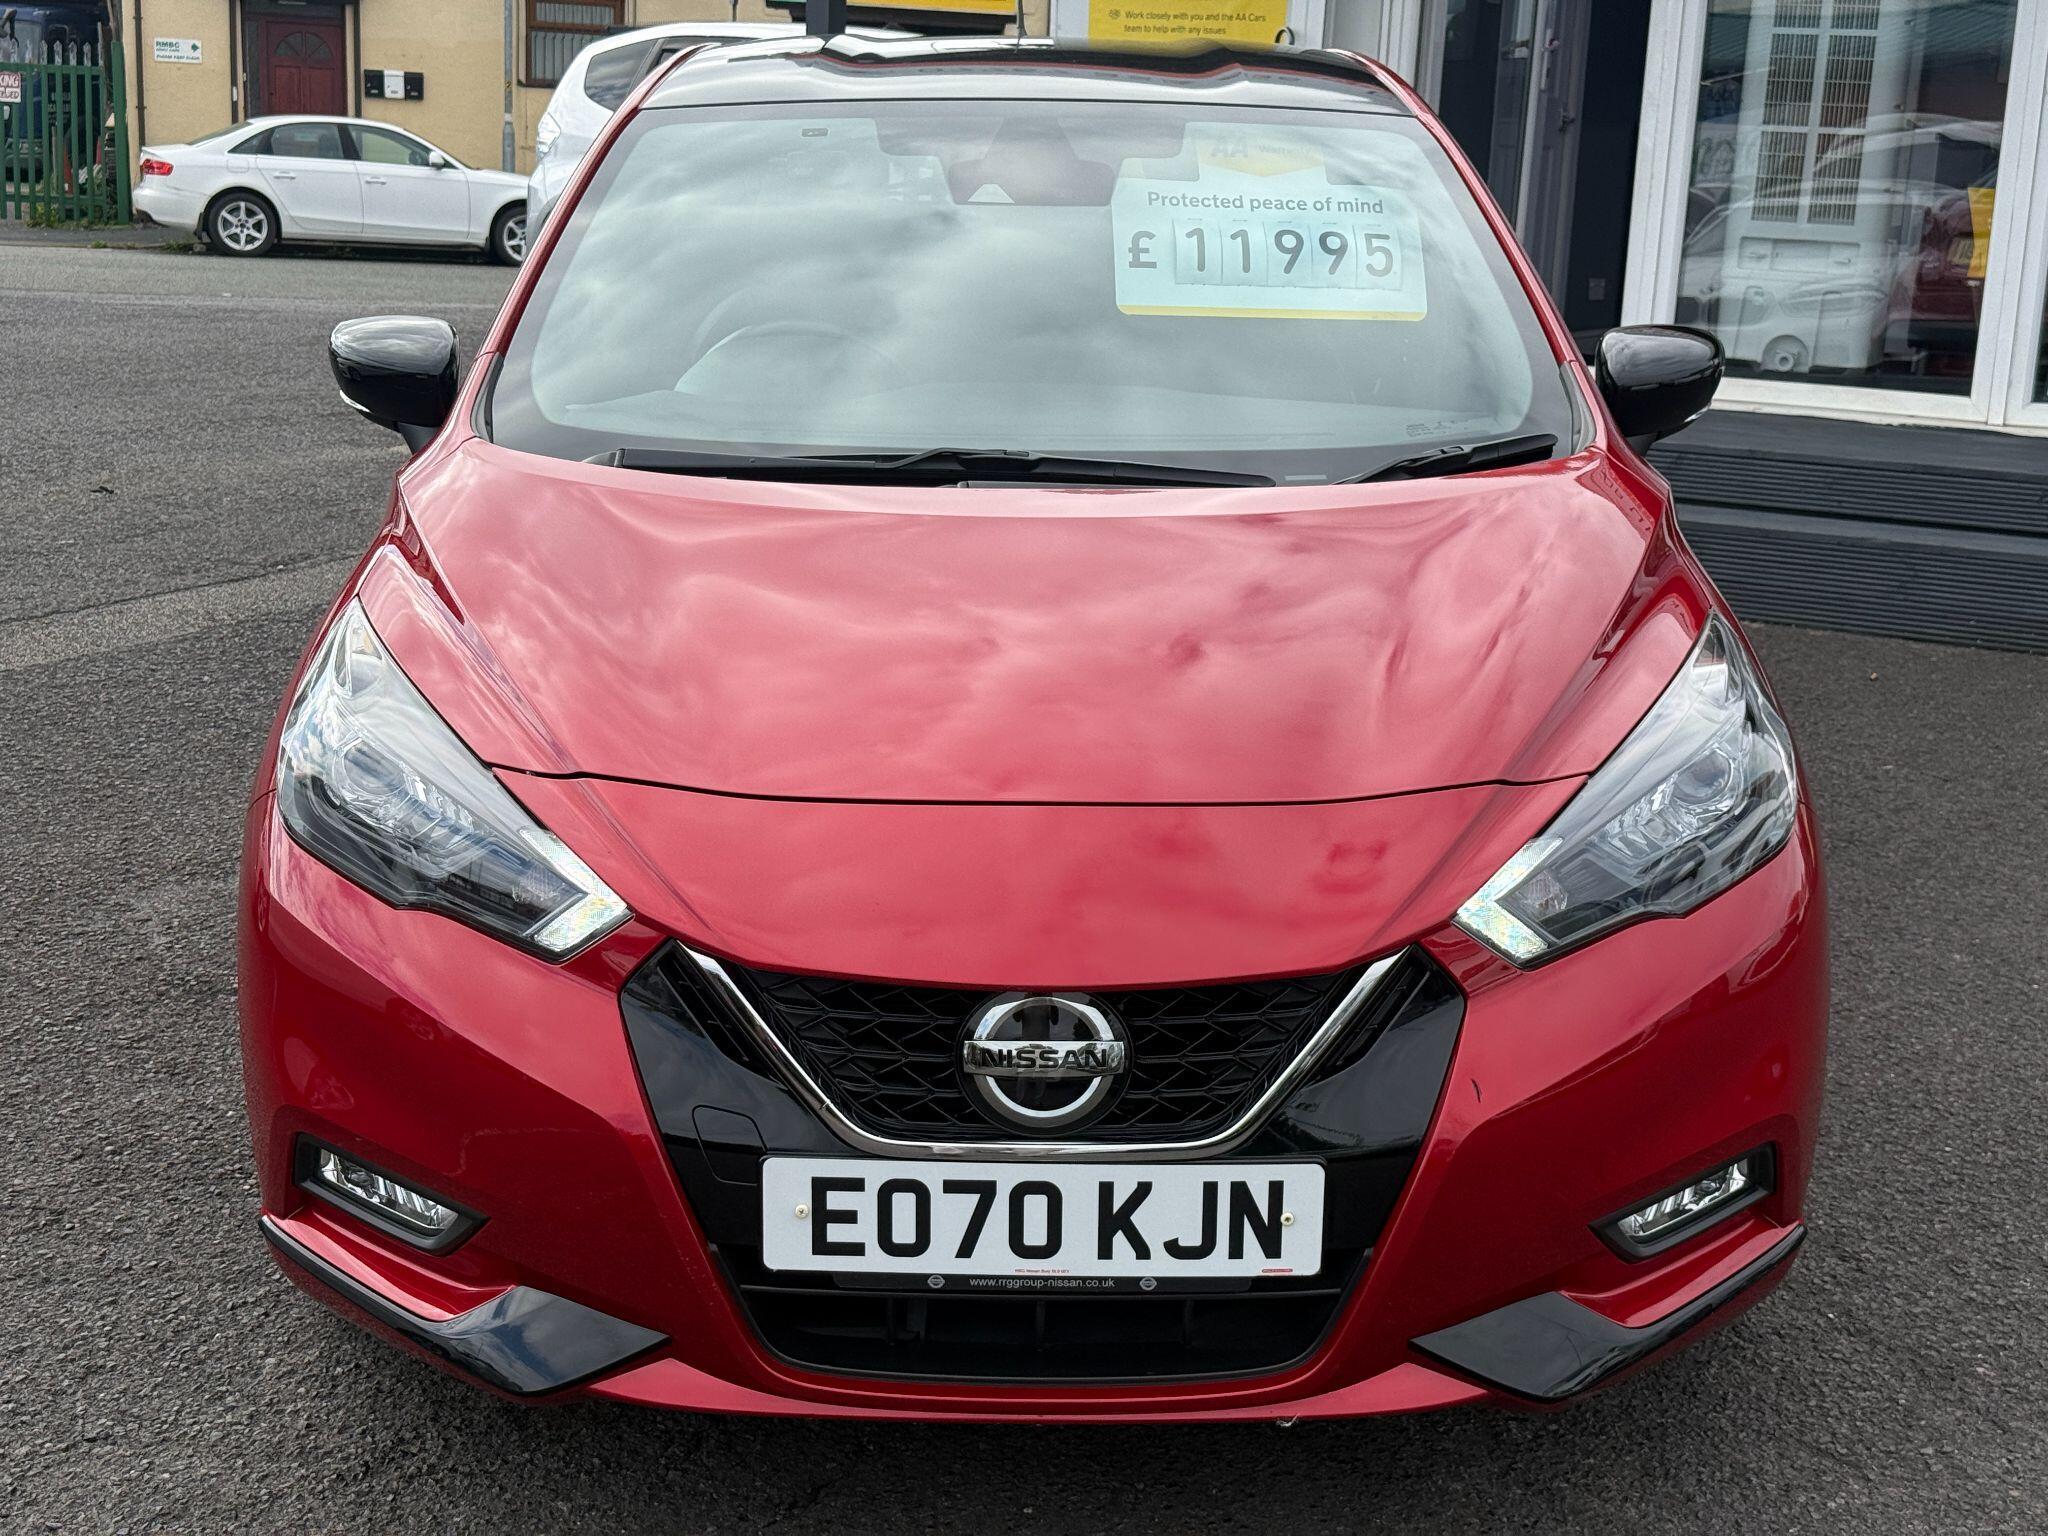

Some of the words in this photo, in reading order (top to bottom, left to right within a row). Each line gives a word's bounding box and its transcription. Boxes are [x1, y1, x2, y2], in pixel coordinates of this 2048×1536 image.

[1124, 11, 1144, 20] Work
[1146, 11, 1171, 21] closely
[1172, 12, 1189, 20] with
[1190, 13, 1202, 22] you
[1205, 13, 1219, 21] and
[1220, 13, 1234, 21] the
[1235, 13, 1247, 22] AA
[1248, 13, 1267, 22] Cars
[1124, 25, 1143, 33] team
[1143, 25, 1152, 33] to
[1153, 25, 1169, 34] help
[1170, 26, 1186, 34] with
[1187, 27, 1201, 36] any
[1203, 26, 1227, 35] issues
[1147, 191, 1243, 210] Protected
[1250, 196, 1308, 213] peace
[1312, 197, 1332, 212] of
[1338, 200, 1383, 214] mind
[981, 1048, 1107, 1069] NISSAN
[811, 1176, 1063, 1260] EO70
[1097, 1179, 1284, 1260] KJN
[969, 1277, 1116, 1289] www.rrggroup-nissan.co.uk
